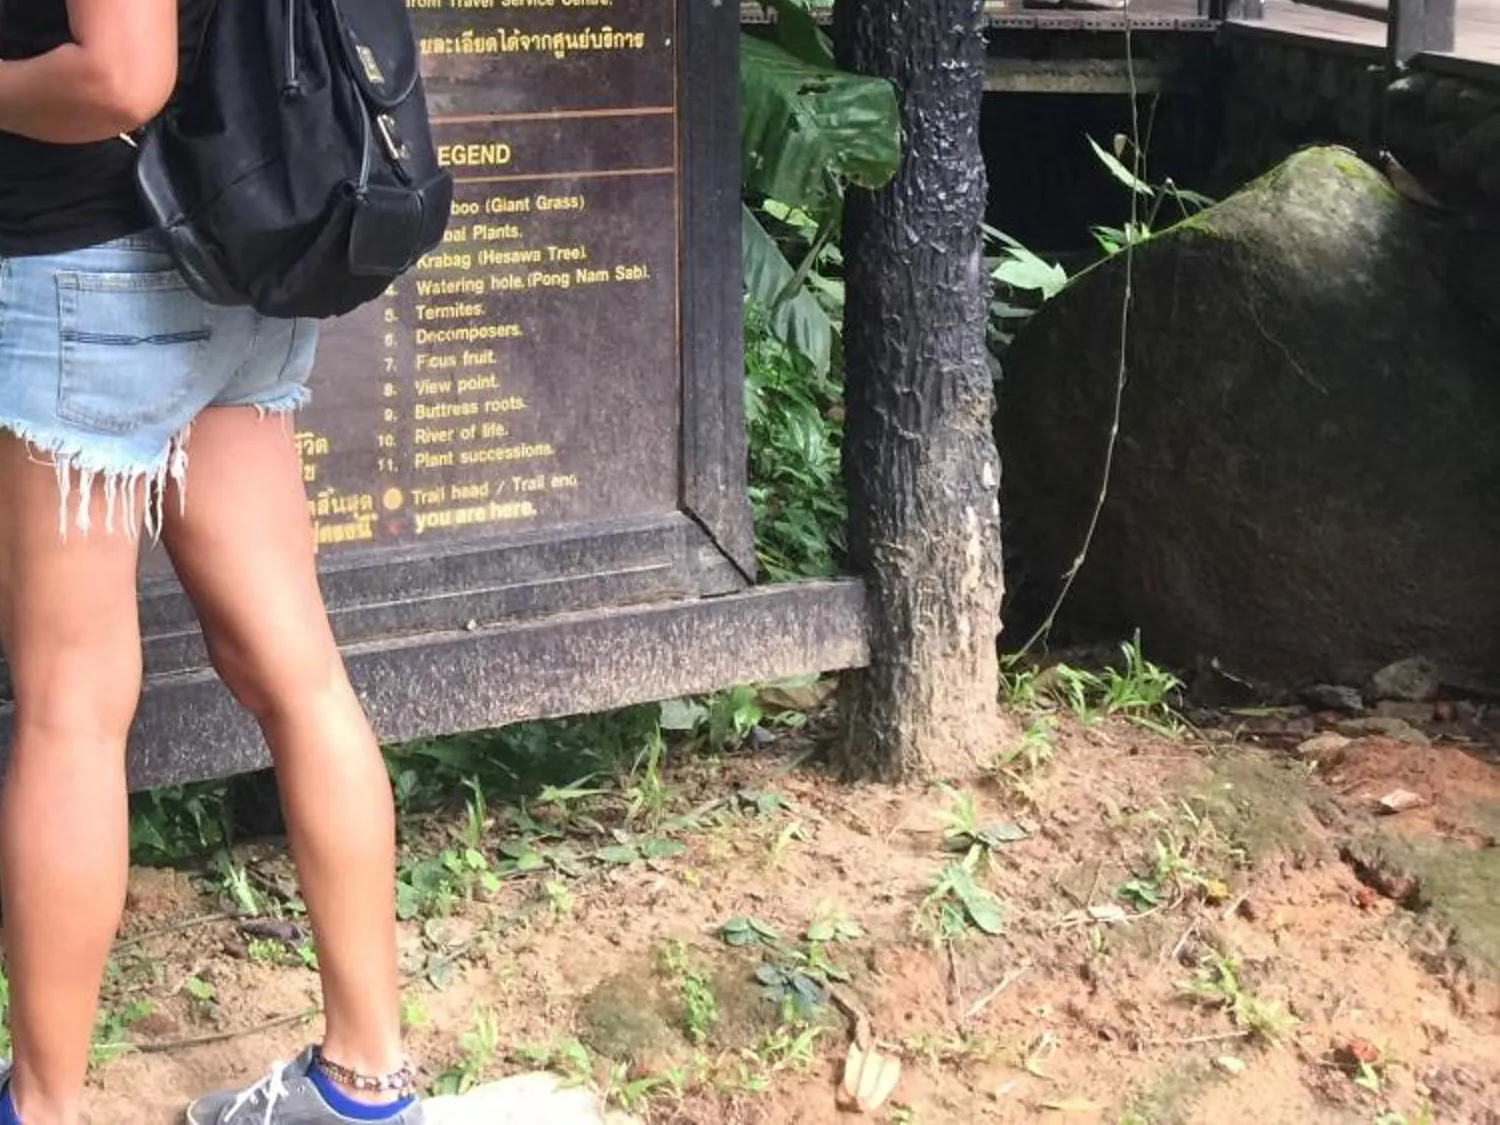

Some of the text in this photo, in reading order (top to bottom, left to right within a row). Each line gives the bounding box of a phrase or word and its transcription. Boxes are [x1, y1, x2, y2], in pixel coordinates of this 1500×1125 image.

[437, 144, 511, 167] EGEND
[536, 194, 585, 211] Grass)
[473, 225, 524, 241] Plants.
[416, 277, 485, 297] Watering
[576, 266, 610, 283] Nam
[416, 301, 486, 321] Termites.
[415, 377, 451, 396] View
[415, 401, 479, 420] Buttress
[415, 427, 454, 444] River
[460, 424, 476, 440] of
[415, 450, 454, 469] Plant
[412, 486, 446, 506] Trail
[451, 481, 490, 500] head
[512, 475, 546, 492] Trail
[415, 500, 538, 535] you are here.
